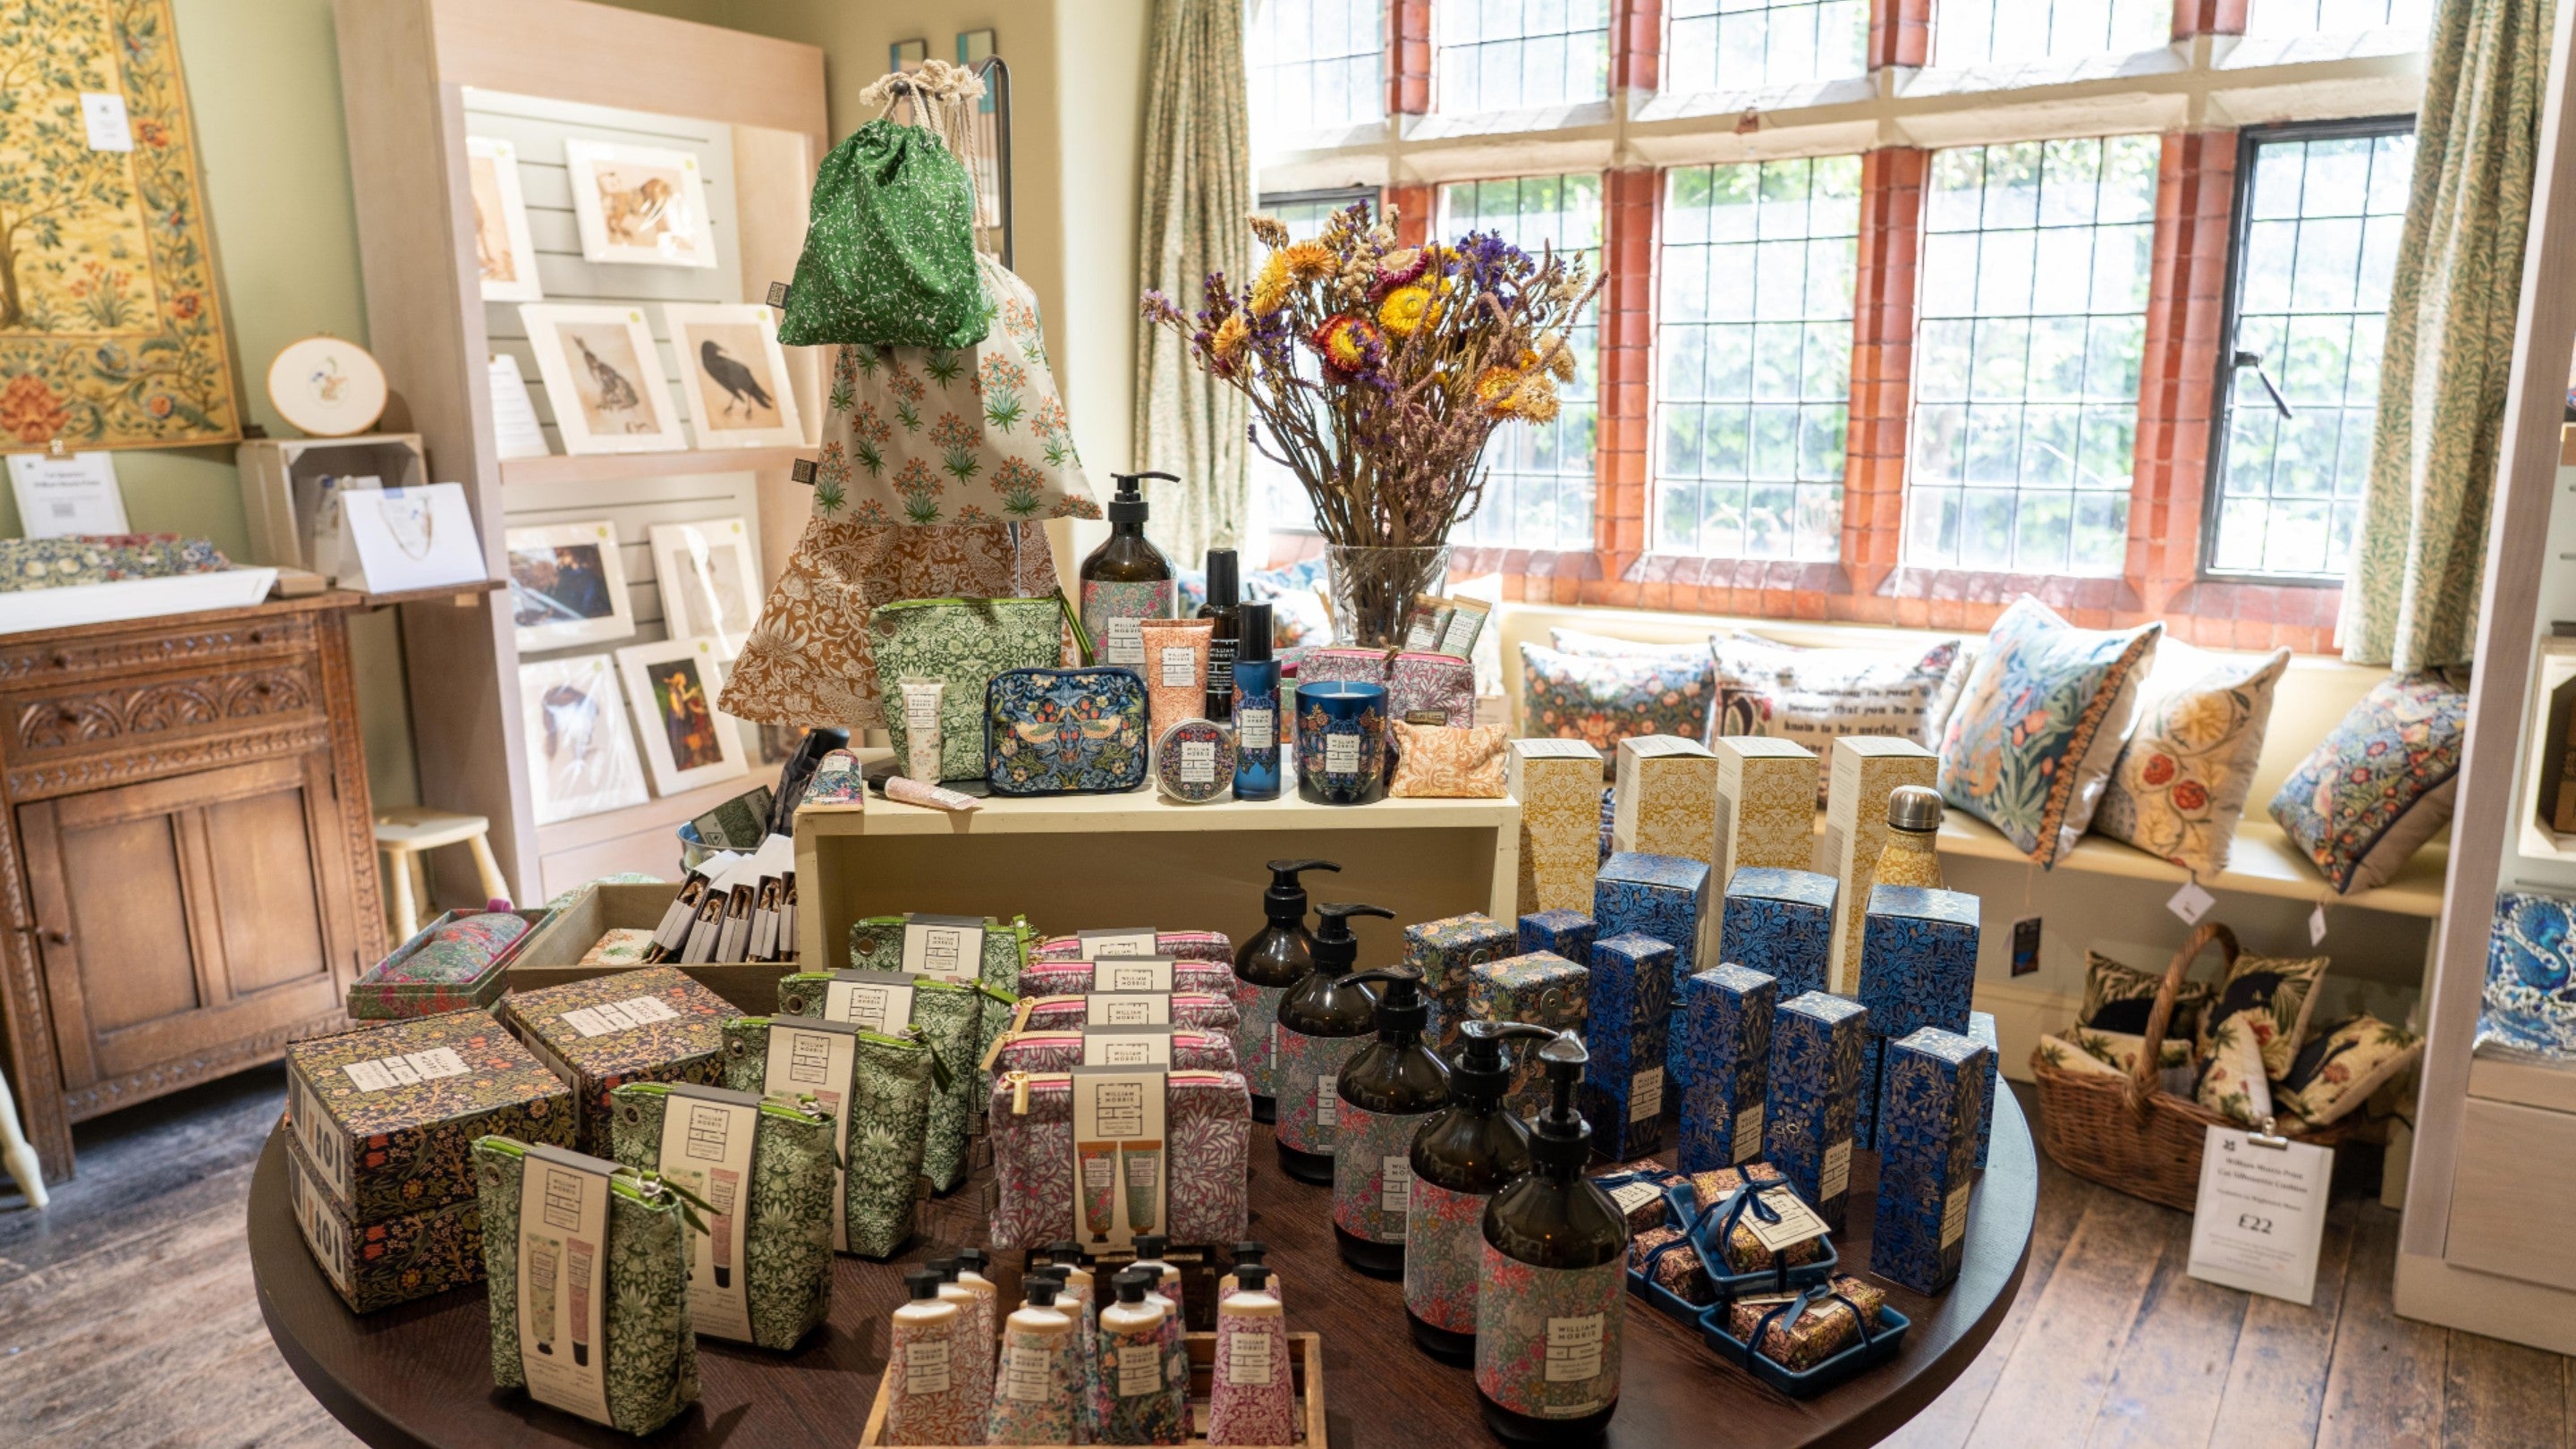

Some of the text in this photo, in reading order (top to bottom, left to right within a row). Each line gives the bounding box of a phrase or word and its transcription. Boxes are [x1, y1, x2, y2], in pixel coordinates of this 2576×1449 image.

[1864, 707, 1885, 717] you
[1893, 705, 1907, 715] do
[1784, 720, 1815, 732] know
[1821, 724, 1832, 733] to
[1839, 724, 1851, 734] be
[697, 1119, 722, 1127] MORRIS
[698, 1114, 723, 1122] WILLIAM
[2226, 1158, 2304, 1180] William Morris Print
[553, 1178, 576, 1190] WILLIAM
[553, 1185, 576, 1195] MORRIS
[2275, 1181, 2308, 1194] Cushion
[2238, 1213, 2273, 1235] £22
[1558, 1324, 1597, 1332] WILLIAM
[1558, 1331, 1597, 1340] MORRIS
